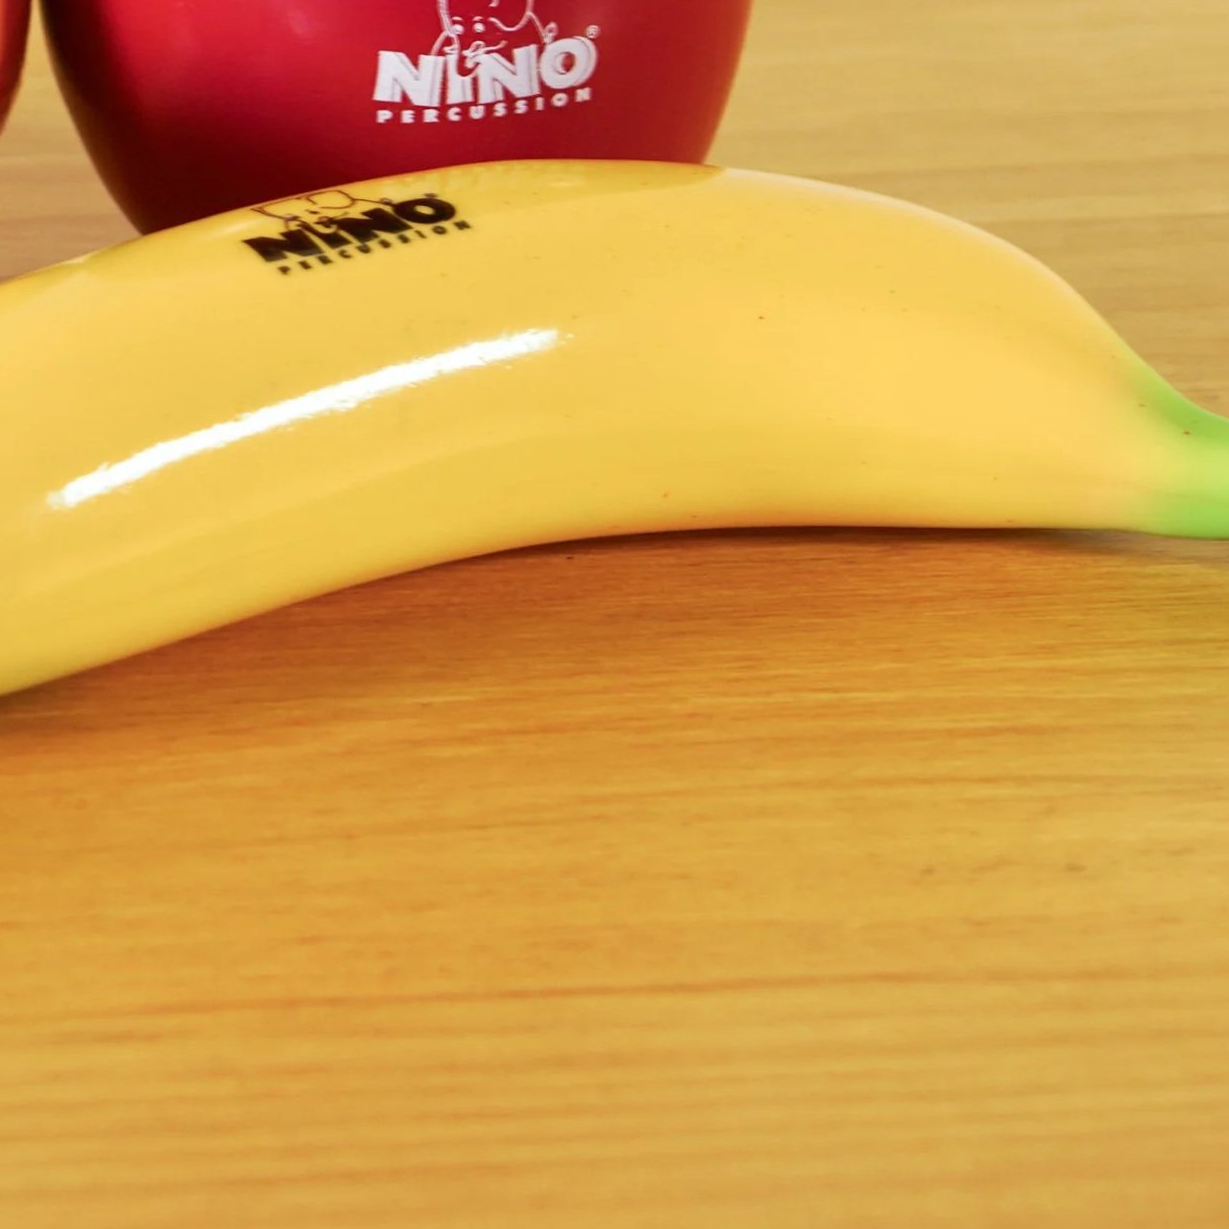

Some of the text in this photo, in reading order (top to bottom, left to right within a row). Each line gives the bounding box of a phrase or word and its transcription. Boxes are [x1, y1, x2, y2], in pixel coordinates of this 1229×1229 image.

[373, 36, 598, 107] NINO
[376, 87, 592, 123] PERCUSSION
[242, 197, 456, 262] NINO
[278, 220, 471, 275] PERCUSSION
